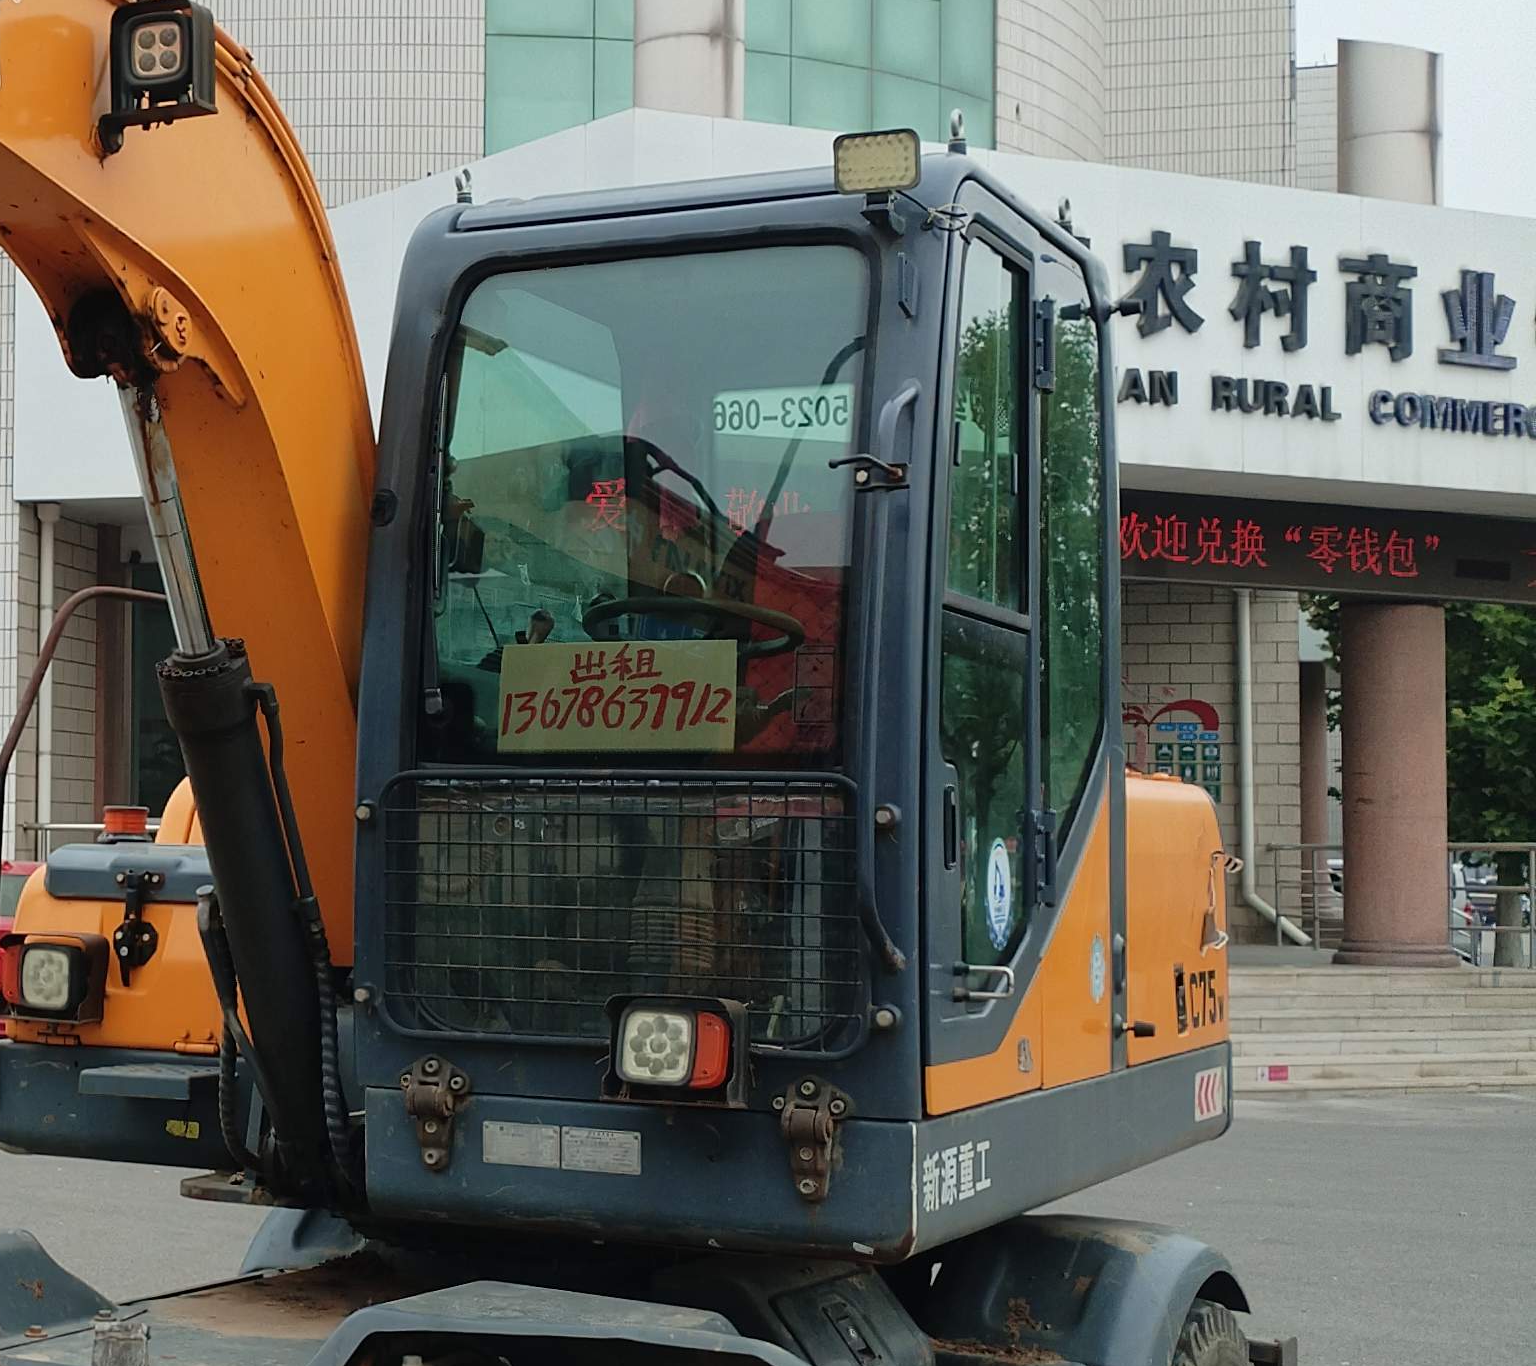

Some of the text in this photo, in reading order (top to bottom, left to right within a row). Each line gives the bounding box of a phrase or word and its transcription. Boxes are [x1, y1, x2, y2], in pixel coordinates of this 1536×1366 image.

[1116, 230, 1518, 371] 农村商业
[1115, 366, 1179, 406] AN
[1211, 375, 1342, 422] RURAL
[569, 643, 662, 684] 出租
[922, 1140, 992, 1212] 新源重工
